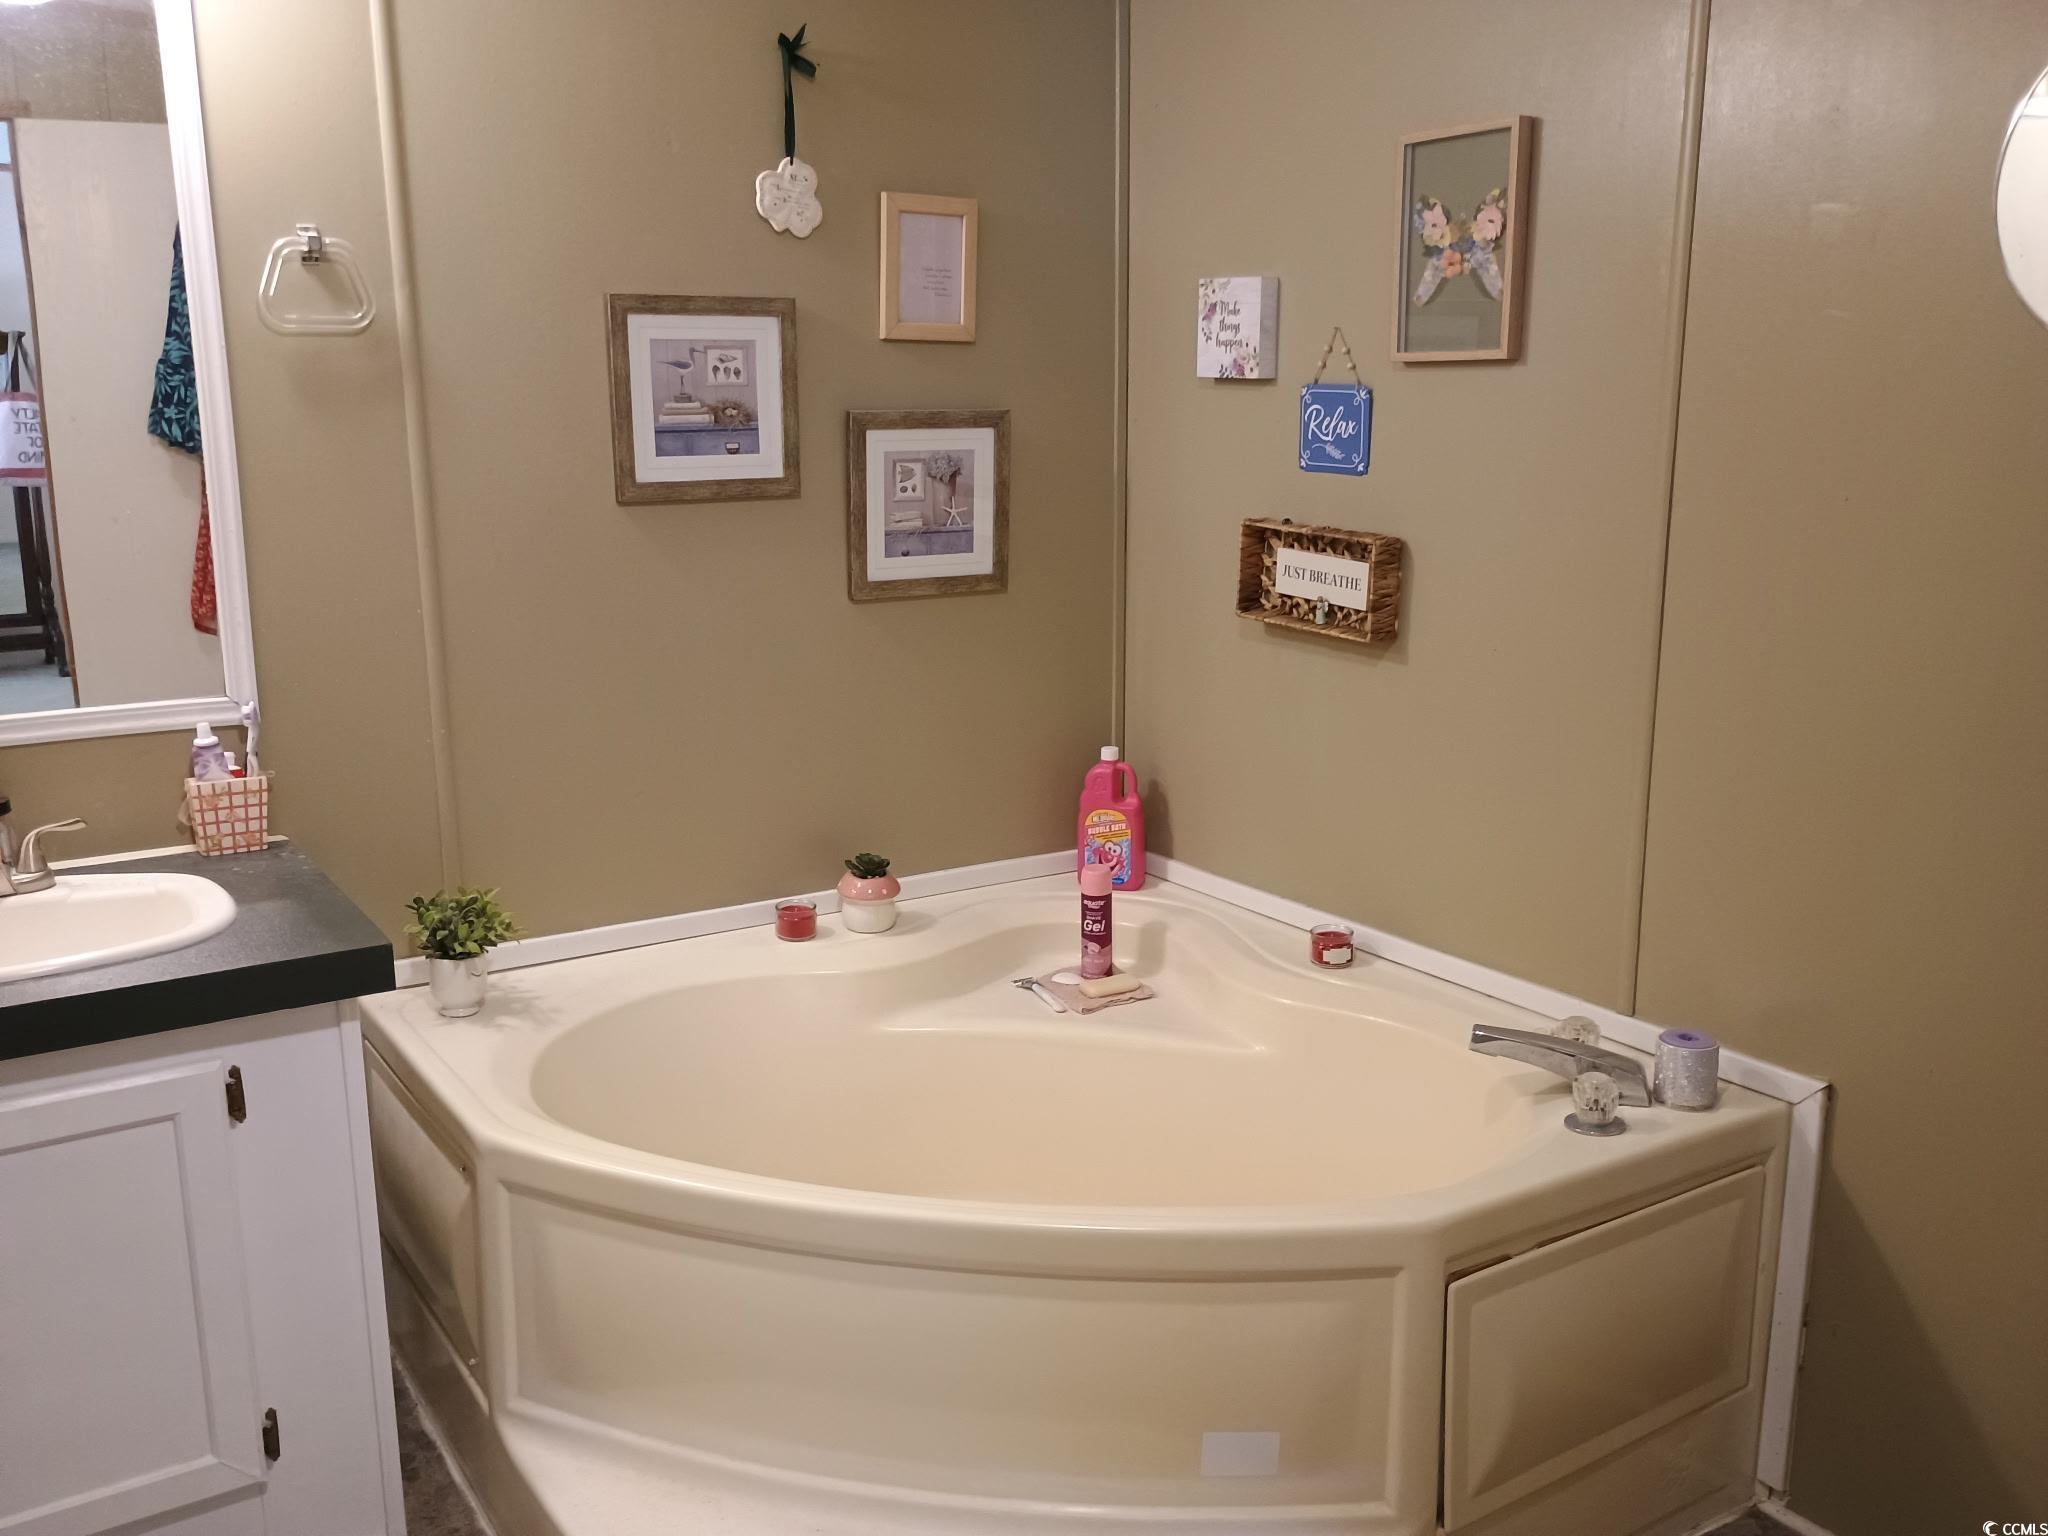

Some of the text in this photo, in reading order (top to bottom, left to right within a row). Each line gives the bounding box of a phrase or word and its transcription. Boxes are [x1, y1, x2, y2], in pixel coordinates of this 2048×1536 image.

[1220, 300, 1241, 317] Make
[1219, 316, 1241, 338] things
[1215, 332, 1243, 354] happen
[1305, 404, 1359, 441] Relax
[1282, 564, 1362, 592] JUST BREATHE
[1083, 920, 1106, 932] Gel
